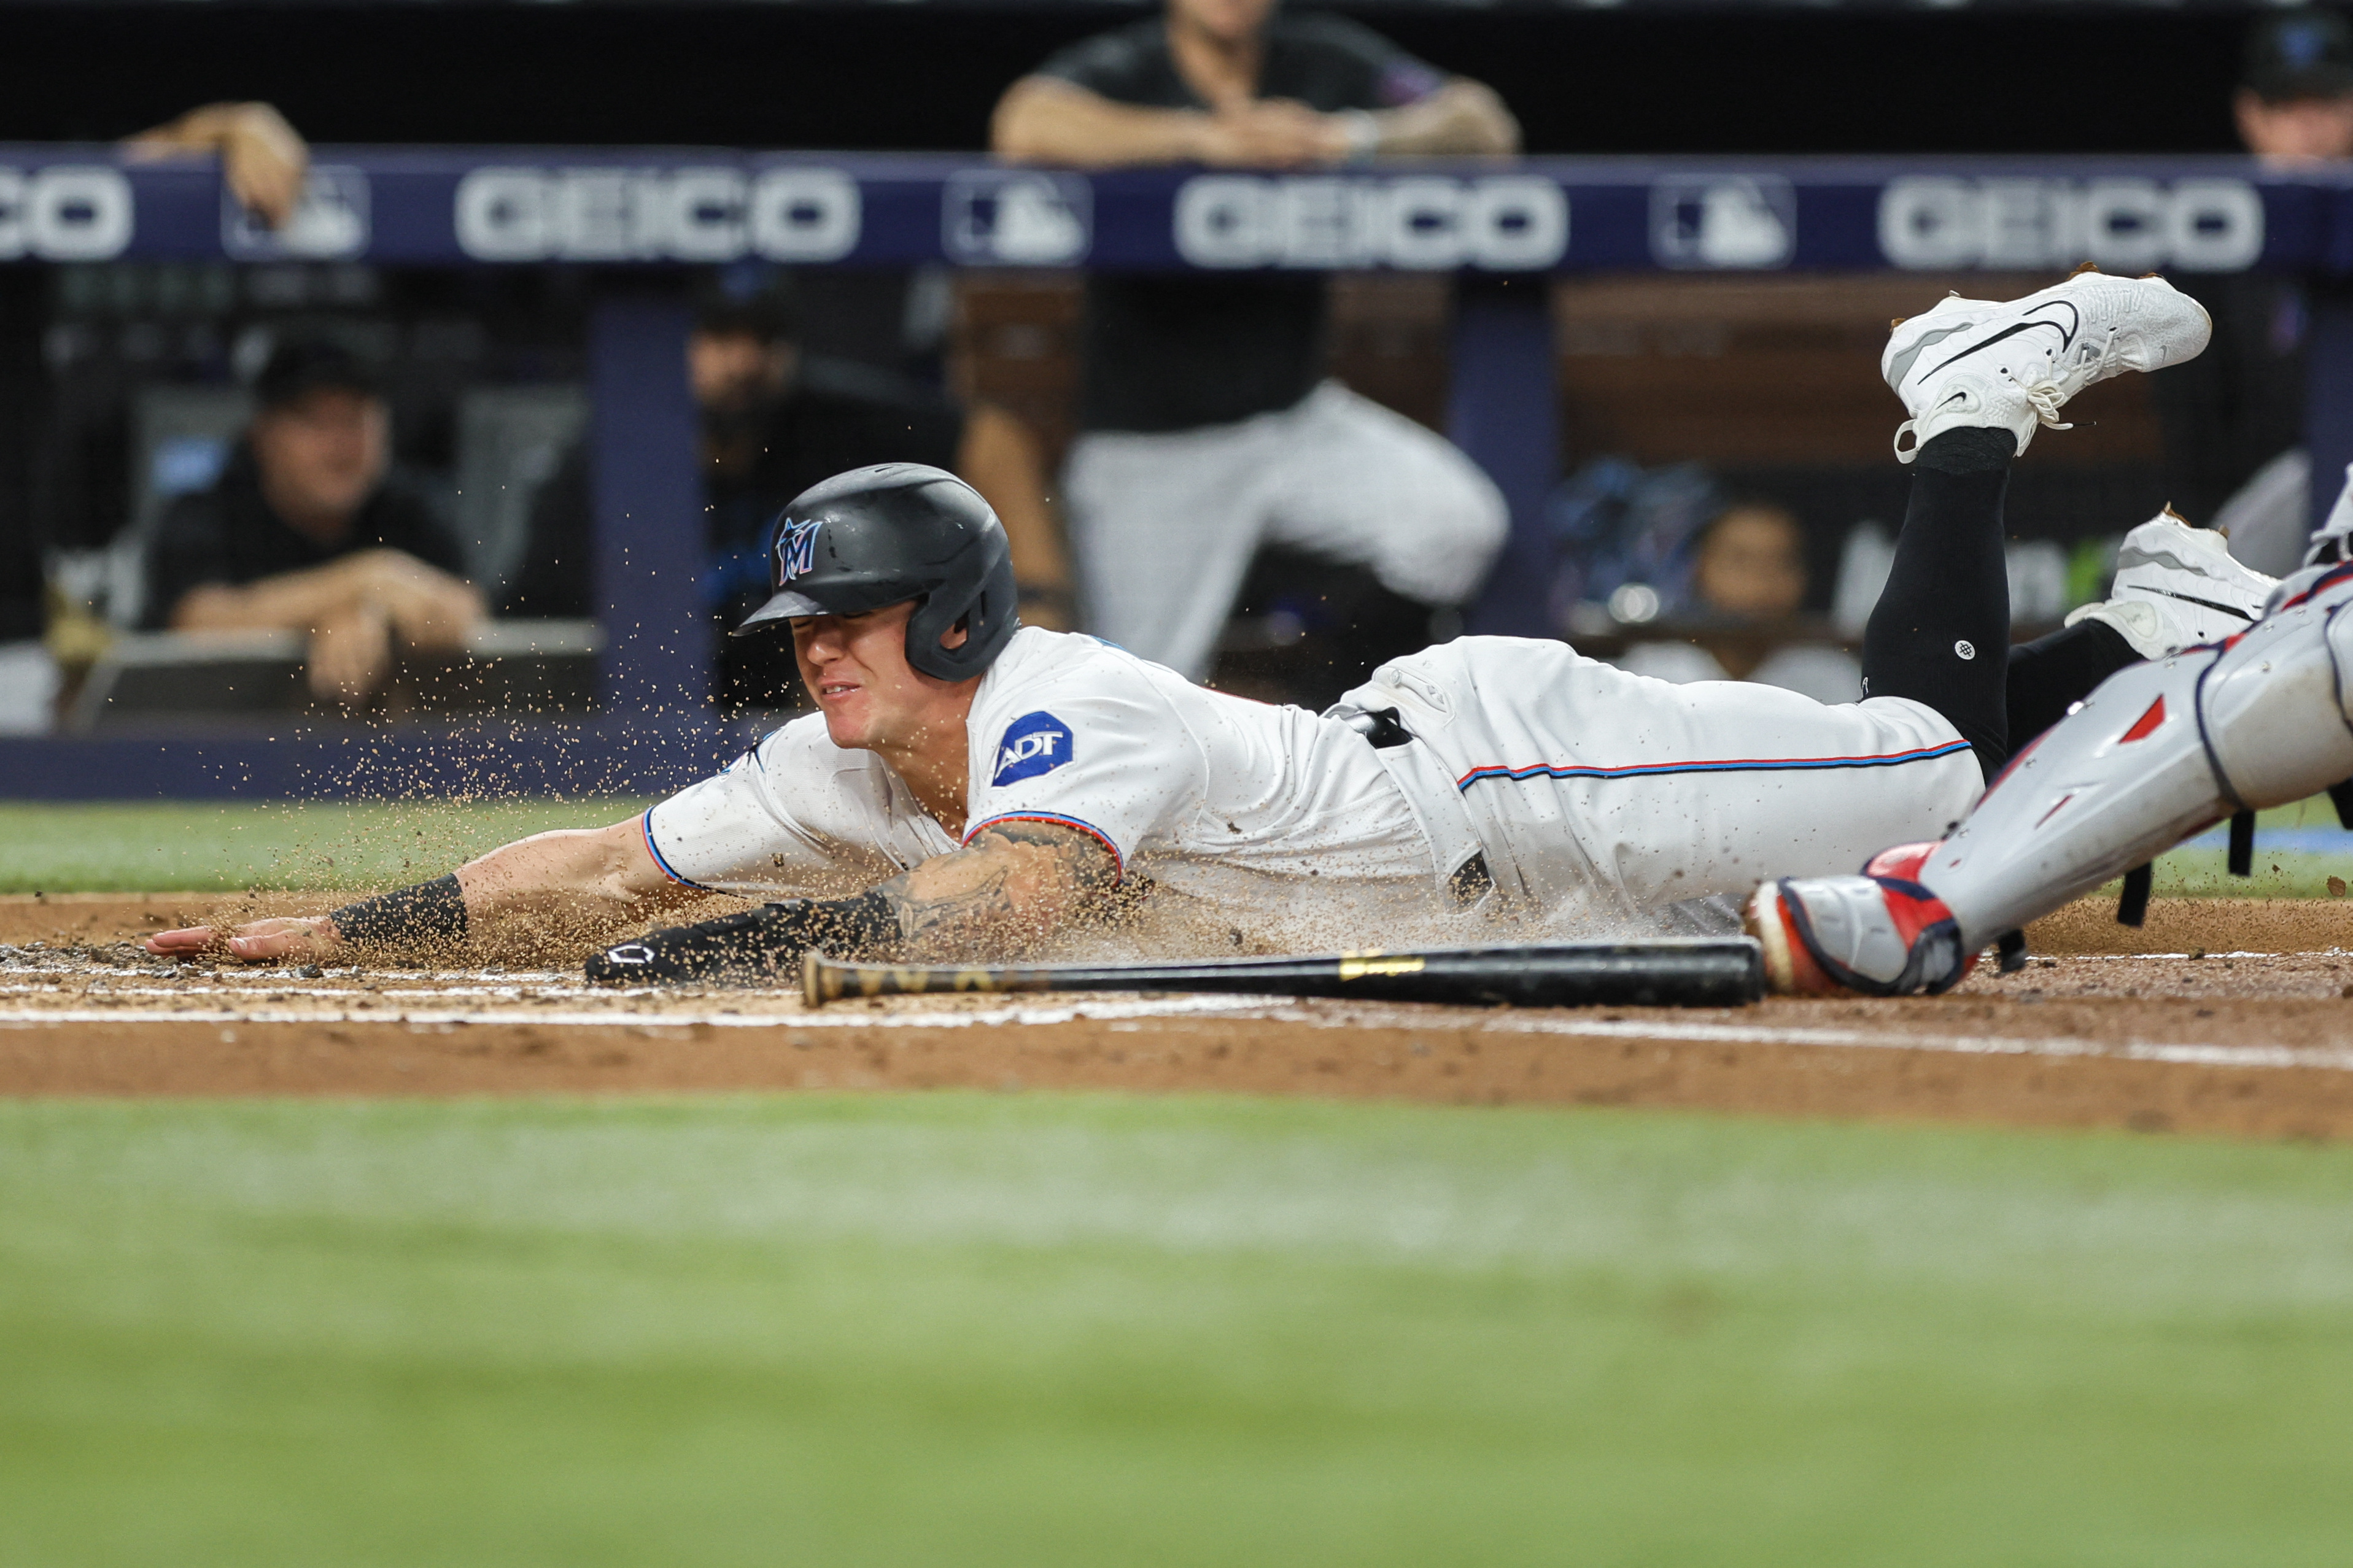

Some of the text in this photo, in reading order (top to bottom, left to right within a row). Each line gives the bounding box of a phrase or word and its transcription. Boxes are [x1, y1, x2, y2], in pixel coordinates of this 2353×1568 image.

[454, 166, 861, 261] GEICO
[1174, 175, 1569, 270] GEICO
[1878, 177, 2264, 271] GEICO
[994, 731, 1064, 779] ADT
